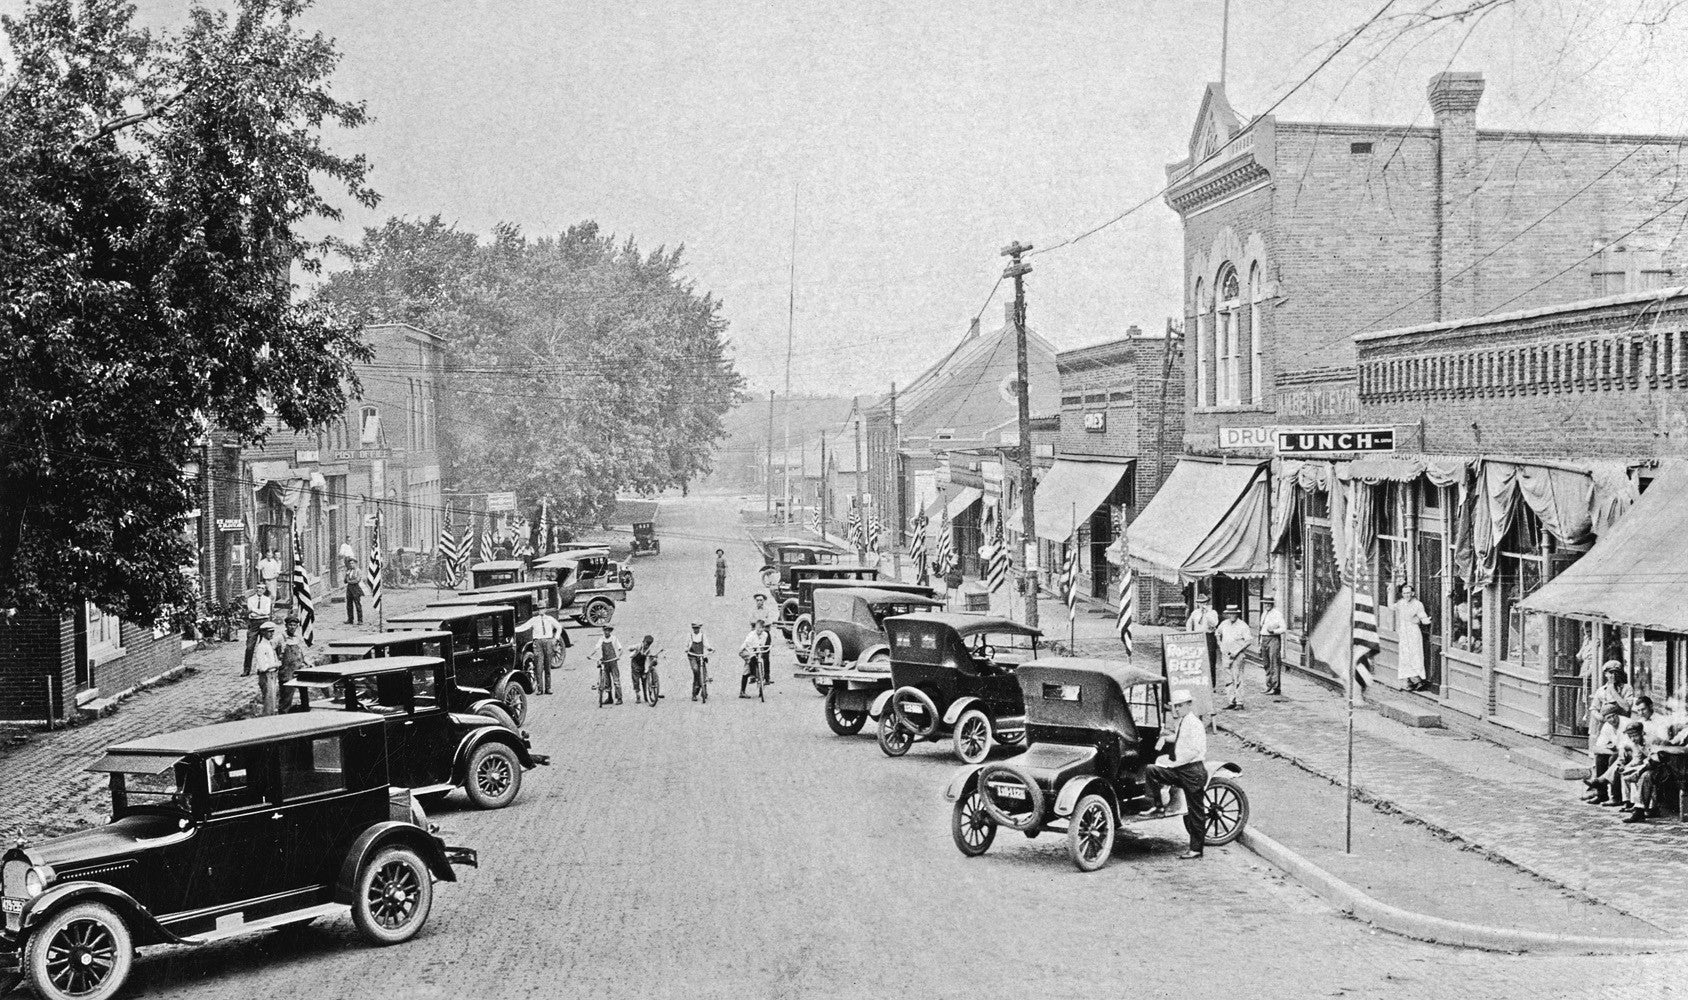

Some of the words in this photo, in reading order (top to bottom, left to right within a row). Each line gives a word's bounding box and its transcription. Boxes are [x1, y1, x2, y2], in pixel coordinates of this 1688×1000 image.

[1280, 433, 1373, 450] LUNCH
[334, 451, 355, 459] POST
[360, 450, 387, 458] OFFICE
[1169, 659, 1203, 671] BEEF
